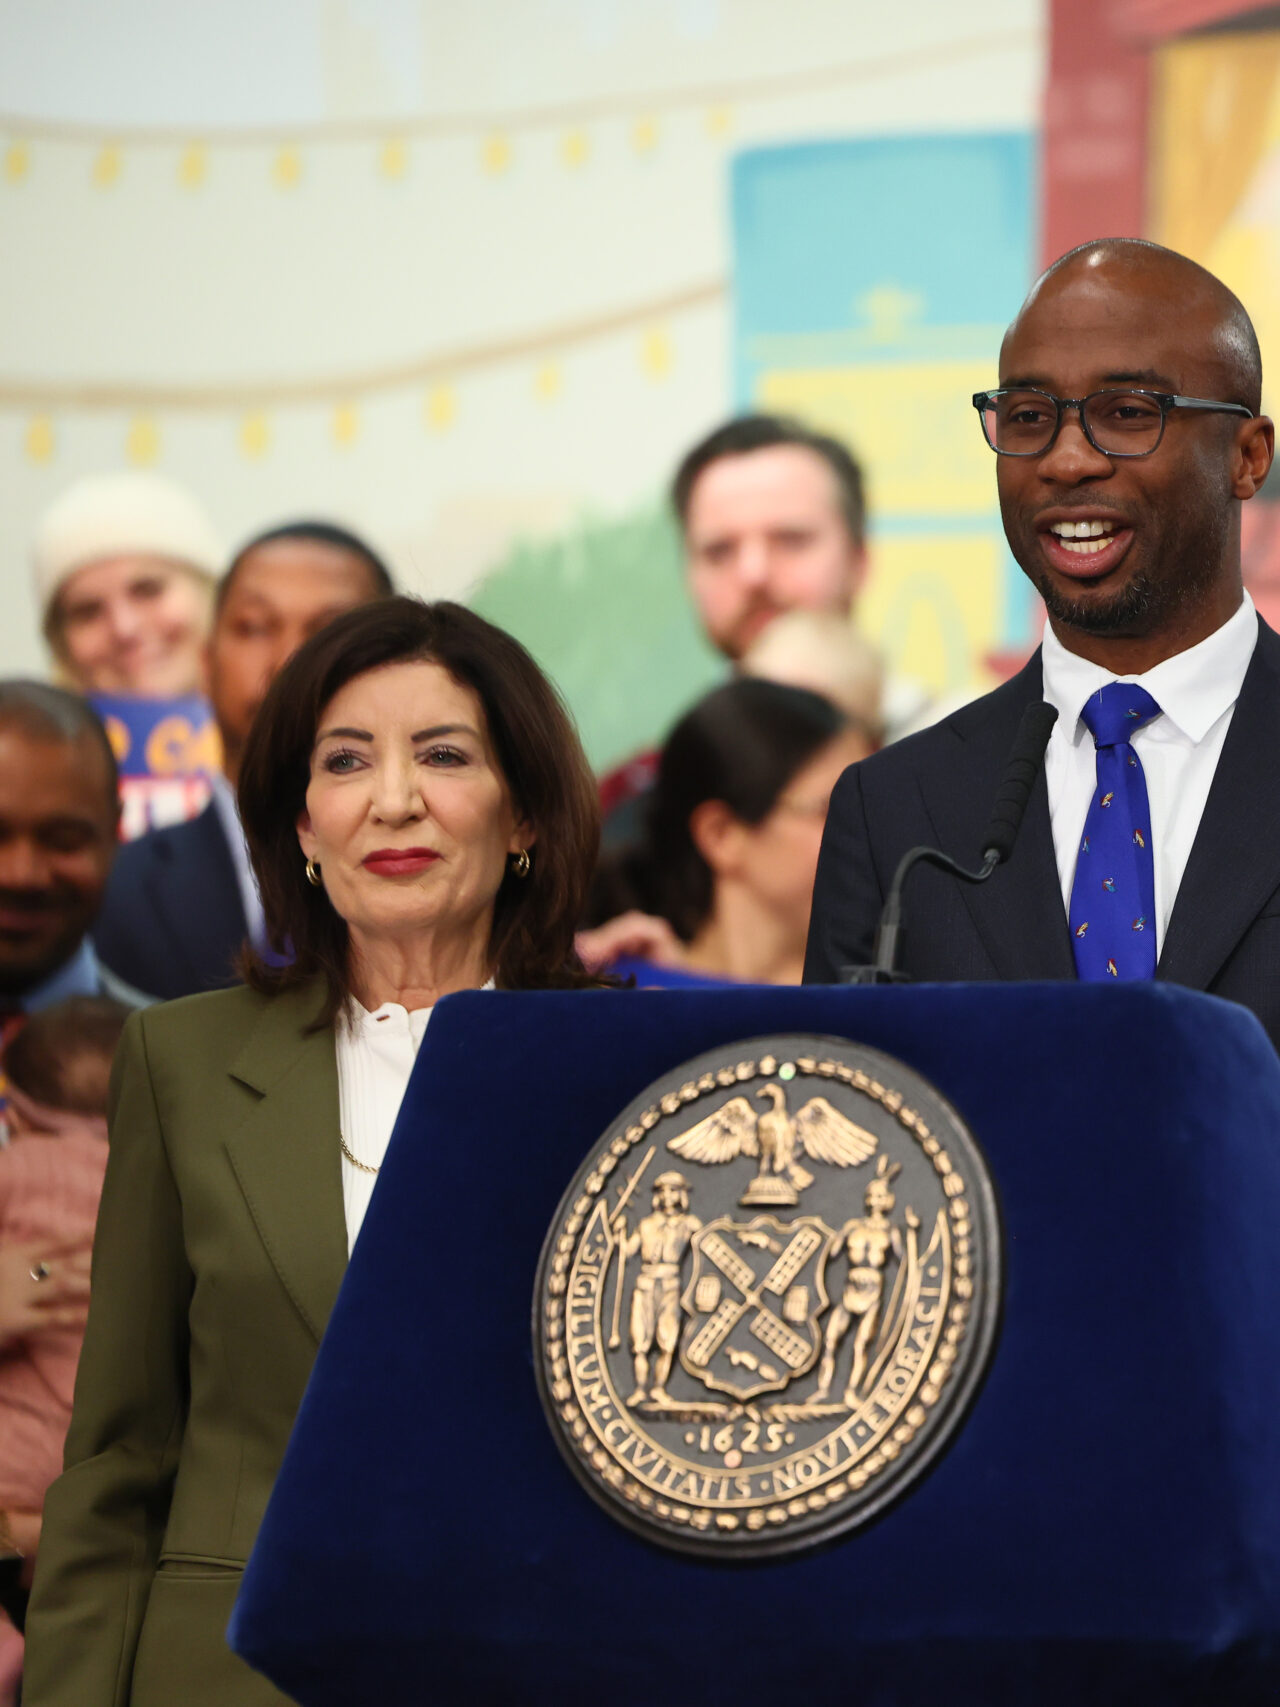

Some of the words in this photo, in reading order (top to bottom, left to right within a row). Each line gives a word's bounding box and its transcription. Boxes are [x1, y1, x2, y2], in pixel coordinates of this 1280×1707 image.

[570, 1242, 611, 1412] SIGILLUM
[603, 1425, 751, 1500] CIVITATIS
[772, 1431, 859, 1496] NOVI
[861, 1286, 941, 1433] EBORACI
[700, 1421, 787, 1453] 1625
